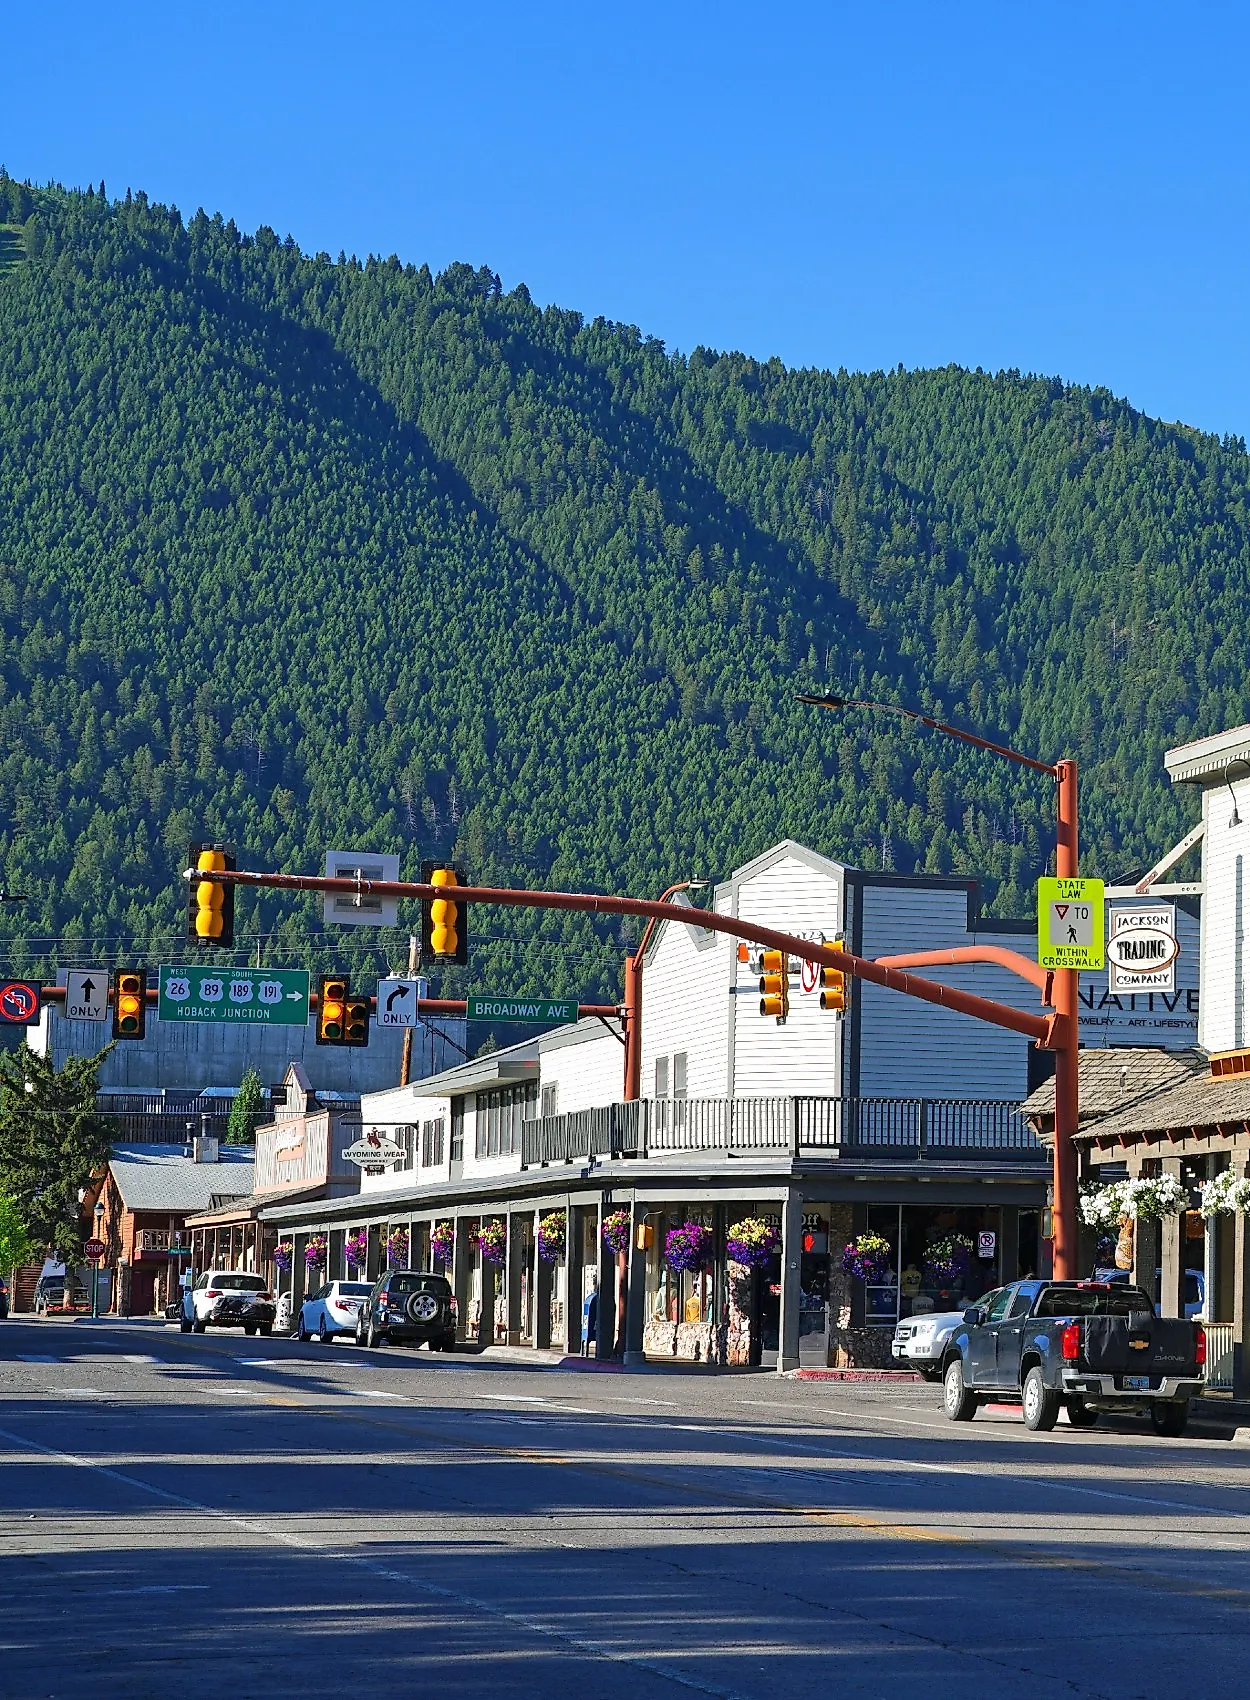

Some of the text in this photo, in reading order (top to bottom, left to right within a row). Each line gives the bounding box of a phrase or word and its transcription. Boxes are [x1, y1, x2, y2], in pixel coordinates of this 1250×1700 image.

[1056, 880, 1086, 890] STATE
[1061, 889, 1081, 899] LAW
[1074, 907, 1089, 920] TO
[1117, 915, 1169, 928] JACKSON
[1055, 947, 1088, 957] WITHIN
[1116, 939, 1167, 961] TRADING
[1042, 956, 1101, 967] CROSSWALK
[1116, 973, 1170, 985] COMPANY
[171, 982, 186, 996] 26
[204, 983, 219, 996] 89
[232, 984, 249, 997] 189
[264, 986, 278, 998] 191
[70, 1006, 101, 1017] ONLY
[177, 1006, 271, 1019] HOBACK JUNCTION
[475, 1002, 570, 1018] BROADWAY AVE
[383, 1013, 412, 1024] ONLY
[1078, 1017, 1115, 1026] EWELRY
[1128, 1019, 1148, 1027] ART
[86, 1244, 104, 1253] STOP
